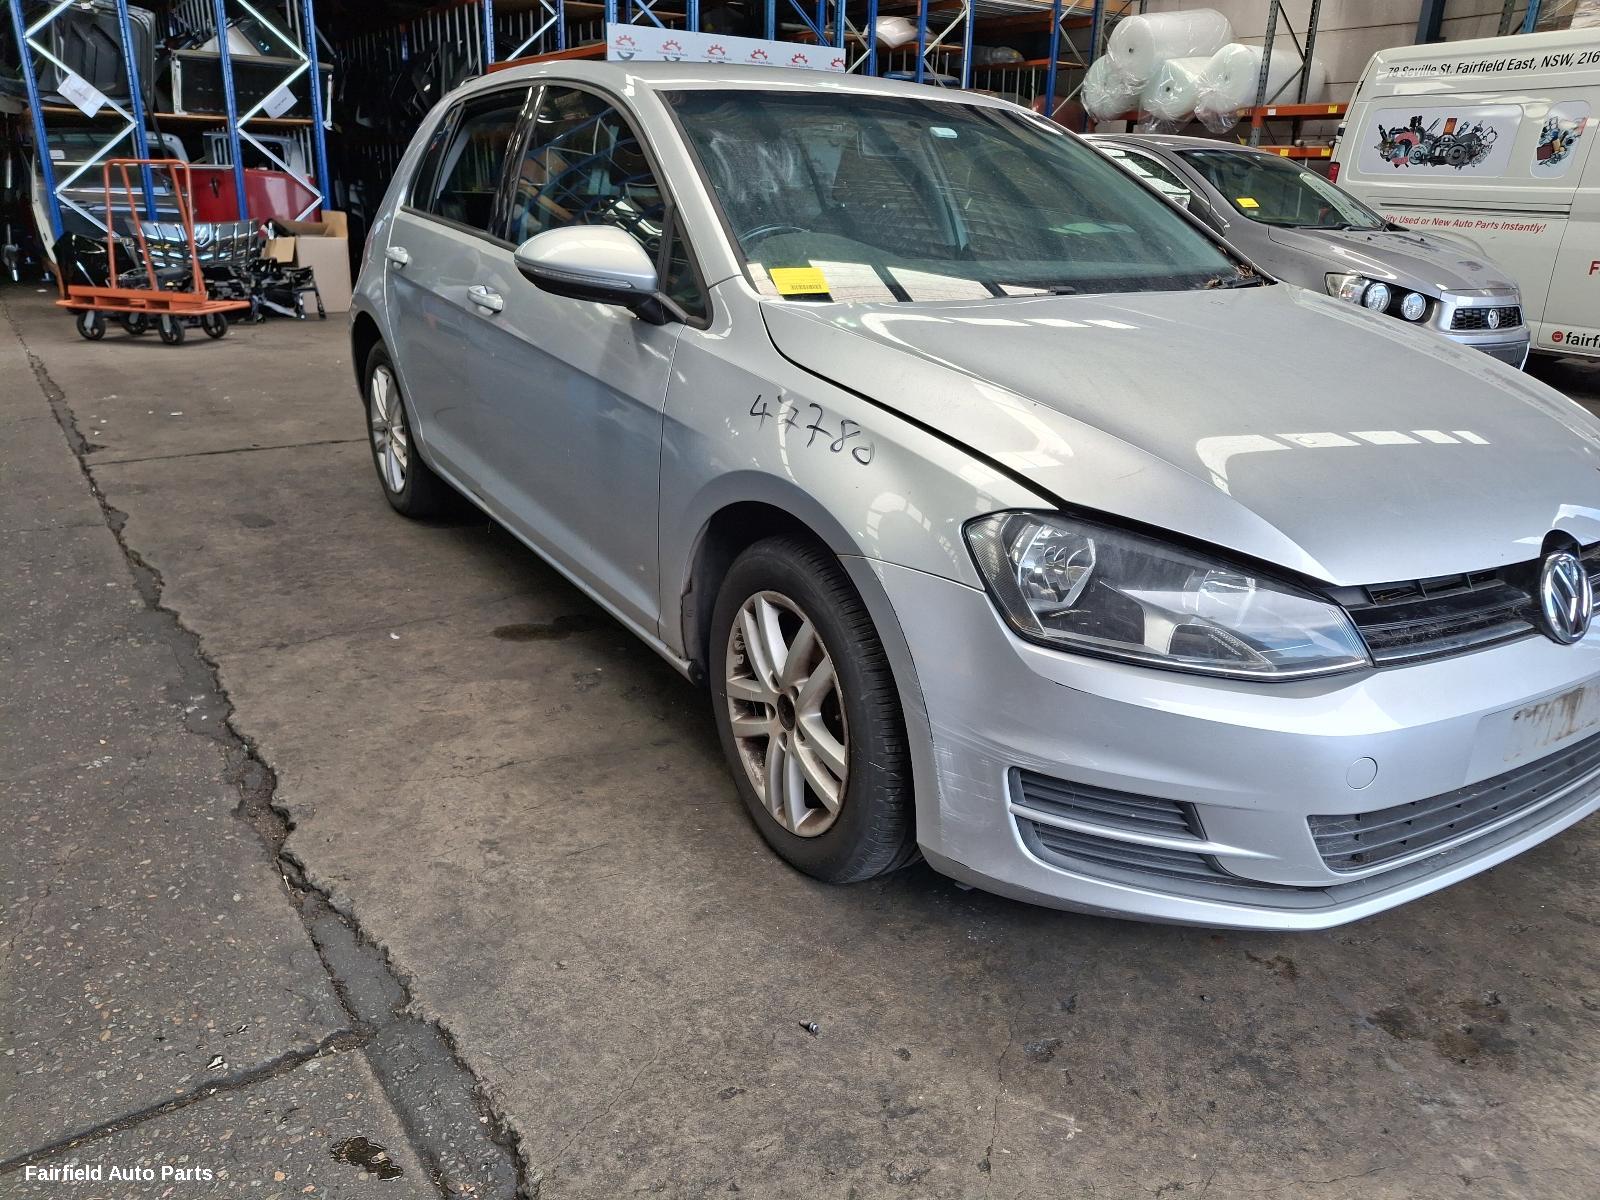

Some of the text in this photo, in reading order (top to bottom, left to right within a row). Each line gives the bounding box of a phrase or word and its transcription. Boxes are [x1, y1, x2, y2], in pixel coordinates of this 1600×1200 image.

[1440, 63, 1453, 74] St.
[1455, 59, 1506, 74] Fairfield
[1507, 57, 1536, 71] East,
[1541, 53, 1574, 68] NSW,
[1399, 215, 1420, 225] Used
[1432, 217, 1451, 227] New
[1452, 219, 1473, 228] Auto
[1475, 220, 1499, 230] Parts
[1501, 221, 1547, 234] Instantly!
[749, 394, 876, 466] 47780
